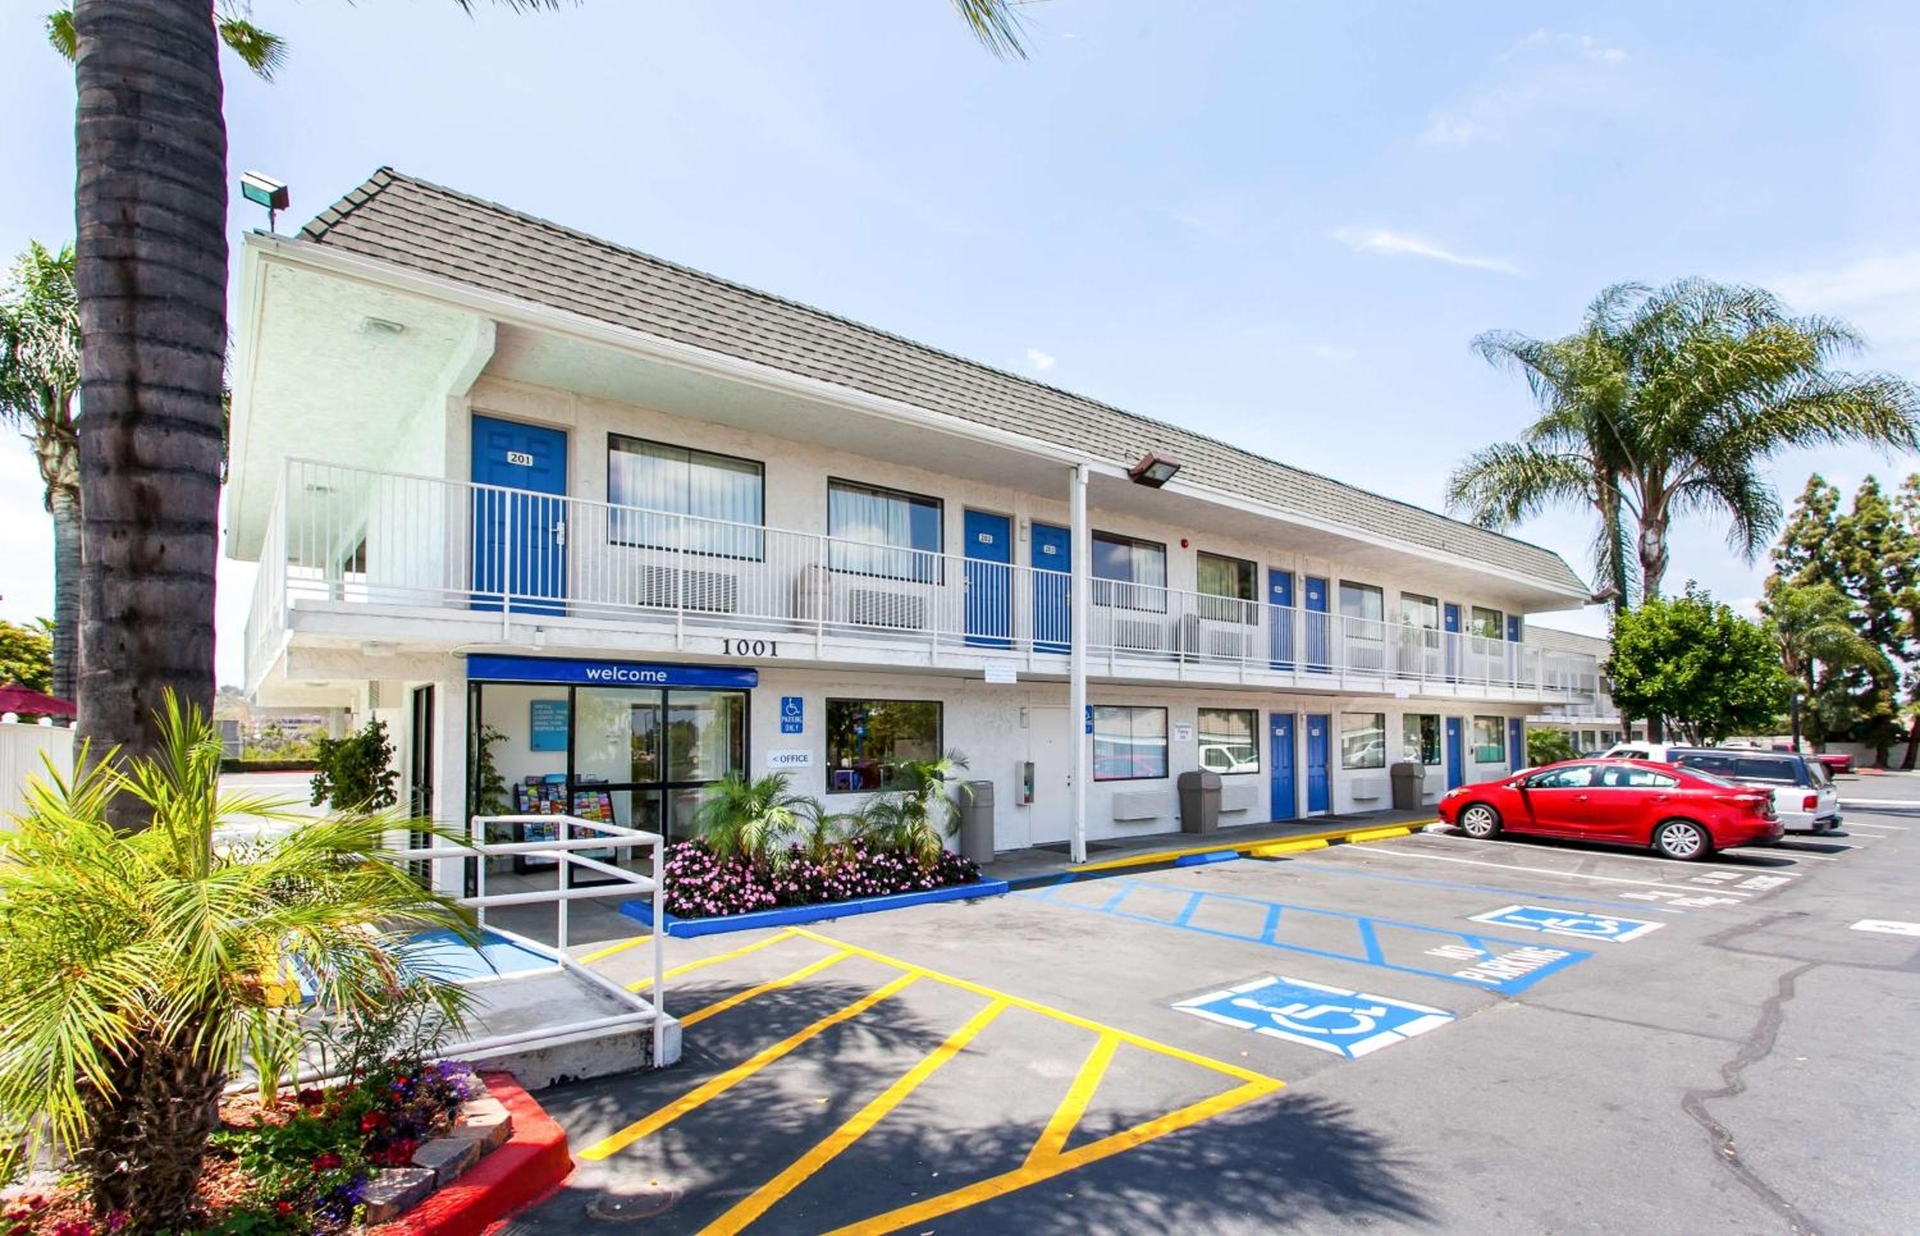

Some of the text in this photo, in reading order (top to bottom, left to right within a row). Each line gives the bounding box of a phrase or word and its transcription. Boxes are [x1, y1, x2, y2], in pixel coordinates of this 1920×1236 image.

[511, 453, 530, 465] 201
[722, 638, 778, 657] 1001
[586, 666, 667, 682] welcome
[784, 724, 799, 732] ONLY
[780, 754, 809, 763] OFFICE
[1423, 945, 1486, 960] NO
[1452, 946, 1571, 984] PARKING
